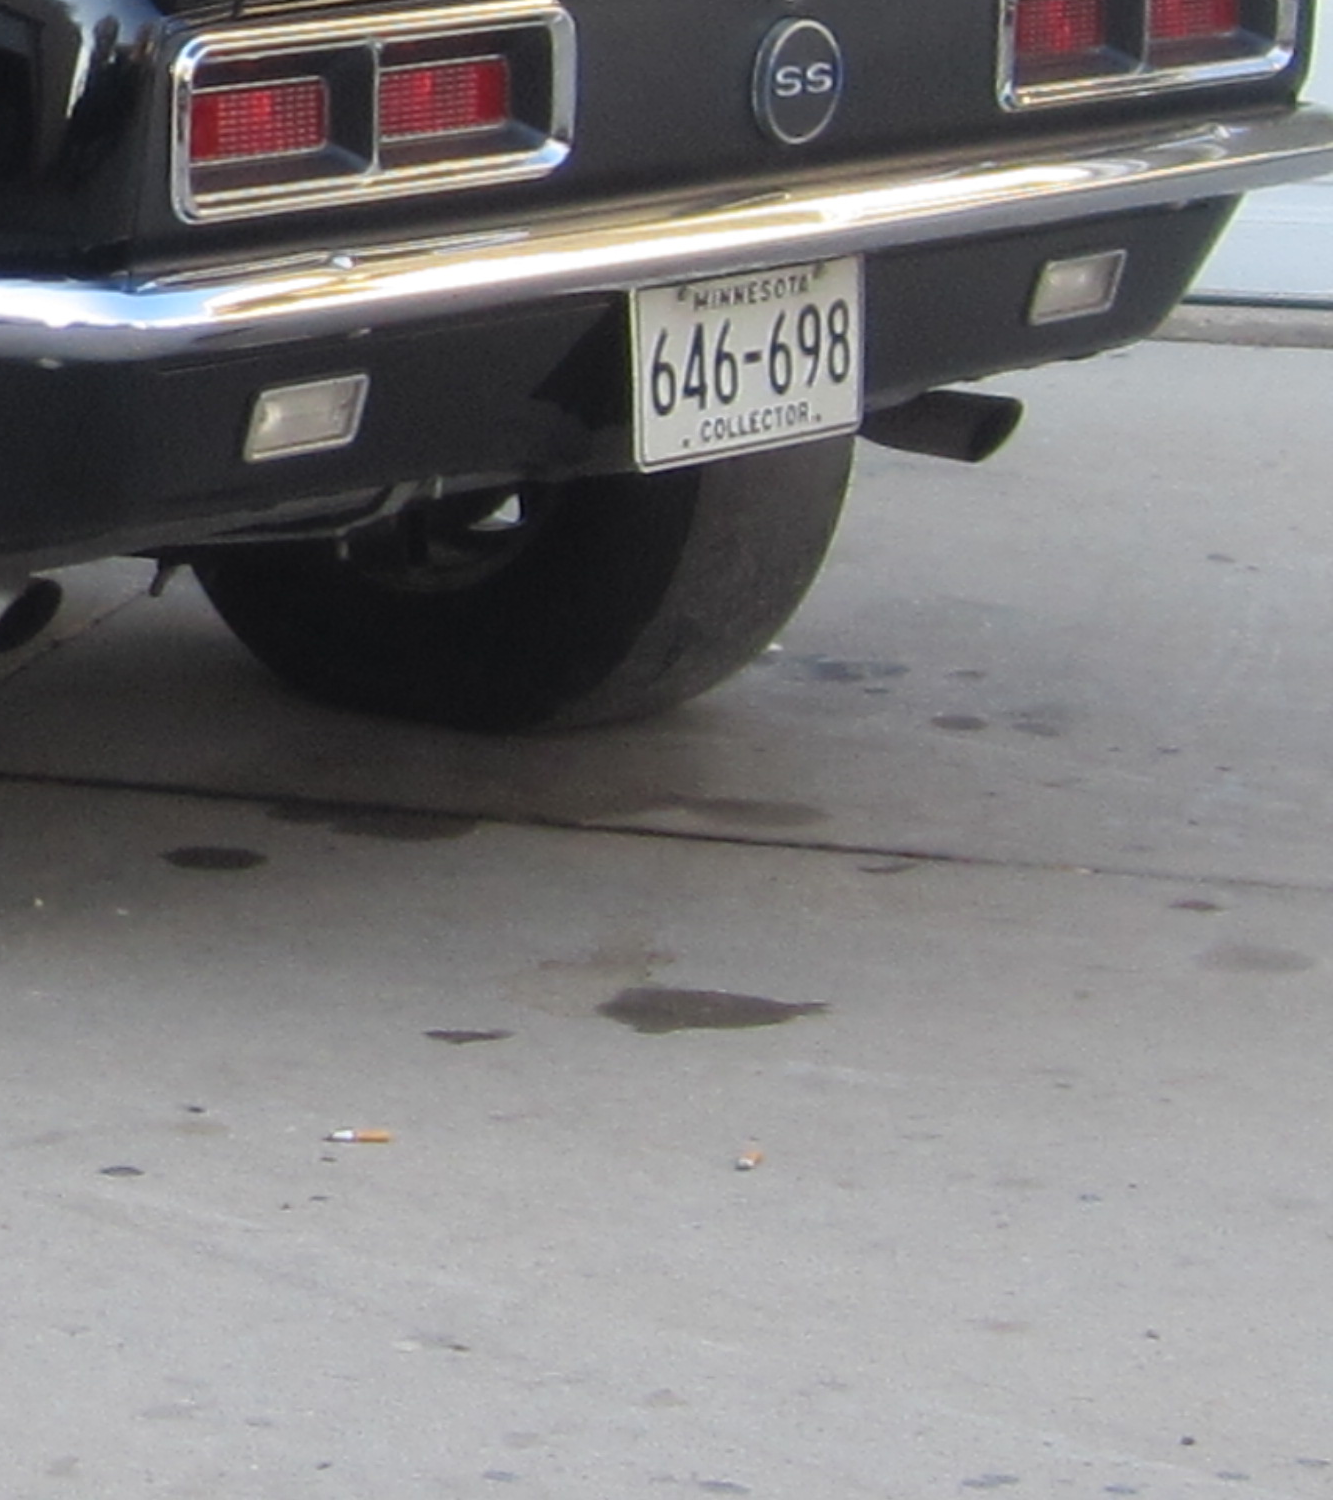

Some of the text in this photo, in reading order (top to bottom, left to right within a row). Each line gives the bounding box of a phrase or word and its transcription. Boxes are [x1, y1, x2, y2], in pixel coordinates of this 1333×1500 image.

[775, 62, 832, 96] SS
[693, 274, 809, 311] MINNESOTA
[651, 299, 850, 416] 646-698
[700, 401, 809, 442] COLLECTOR
